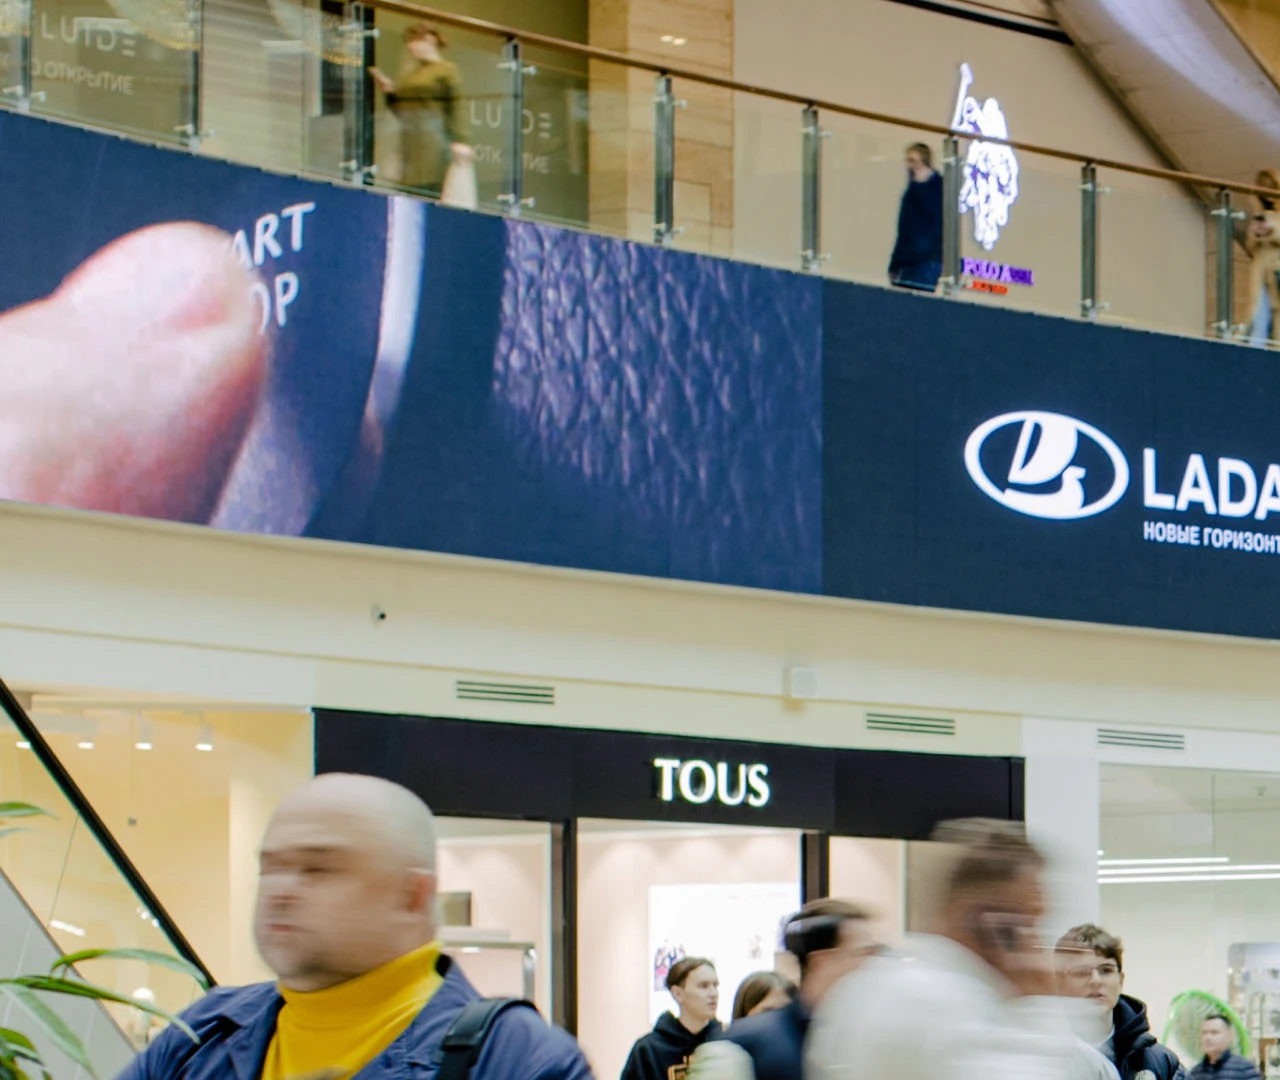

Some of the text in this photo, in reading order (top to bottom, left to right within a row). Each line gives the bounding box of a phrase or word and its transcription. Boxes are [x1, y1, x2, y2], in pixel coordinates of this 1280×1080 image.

[232, 201, 316, 268] ART
[1143, 520, 1201, 546] НОВЫЕ
[654, 758, 770, 808] TOUS
